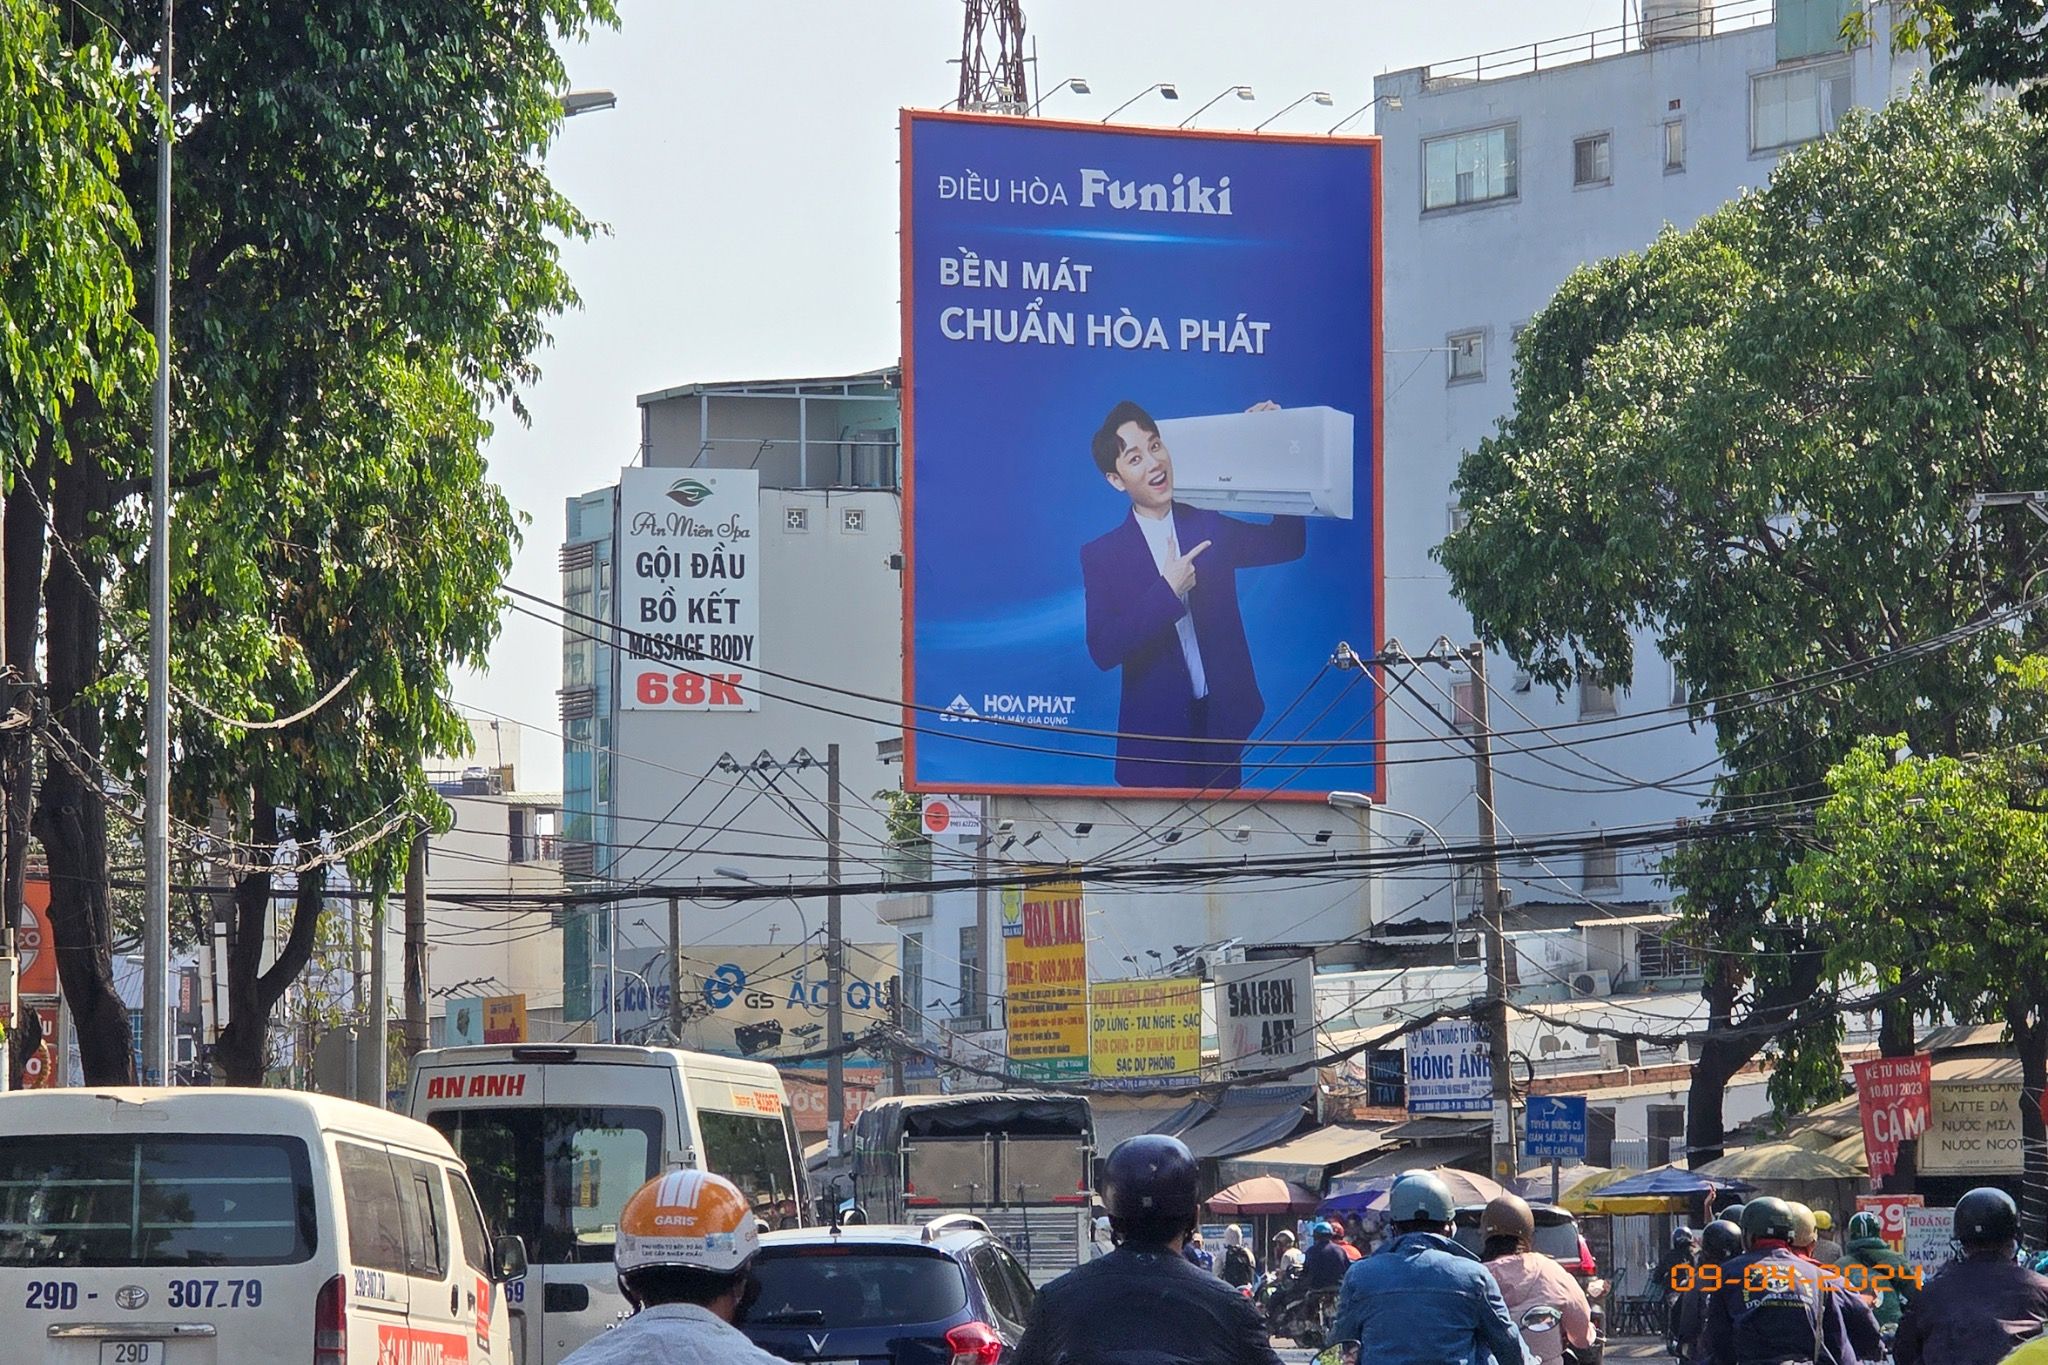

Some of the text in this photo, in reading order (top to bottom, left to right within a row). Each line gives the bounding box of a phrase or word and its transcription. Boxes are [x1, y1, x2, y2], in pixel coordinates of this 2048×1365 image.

[938, 168, 1233, 216] ĐIỀU HÒA Funiki
[940, 246, 1093, 294] BỀN MÁT
[939, 296, 1271, 356] CHUẨN HÒA PHÁT
[717, 513, 751, 543] Spa
[636, 541, 746, 583] GỘI ĐẦU
[640, 586, 741, 625] BỒ KẾT
[629, 633, 754, 662] MASSAGE BODY
[636, 672, 745, 706] 68K
[1027, 716, 1041, 725] GIA
[1043, 716, 1069, 727] DỤNG
[744, 993, 775, 1009] GS
[1228, 979, 1296, 1017] SAIGON
[1152, 1014, 1176, 1030] NGHE
[1261, 1019, 1296, 1056] ART
[1411, 1048, 1492, 1081] HỒNG ÁNH
[1895, 1059, 1922, 1077] NGÀY
[427, 1074, 526, 1099] AN ANH
[1872, 1096, 1926, 1142] CẤM
[1942, 1100, 1984, 1113] LATTE
[1869, 1151, 1883, 1165] XE
[655, 1216, 696, 1227] GARIS
[1864, 1204, 1905, 1231] 39
[26, 1281, 78, 1311] 29D
[115, 1343, 149, 1363] 29D
